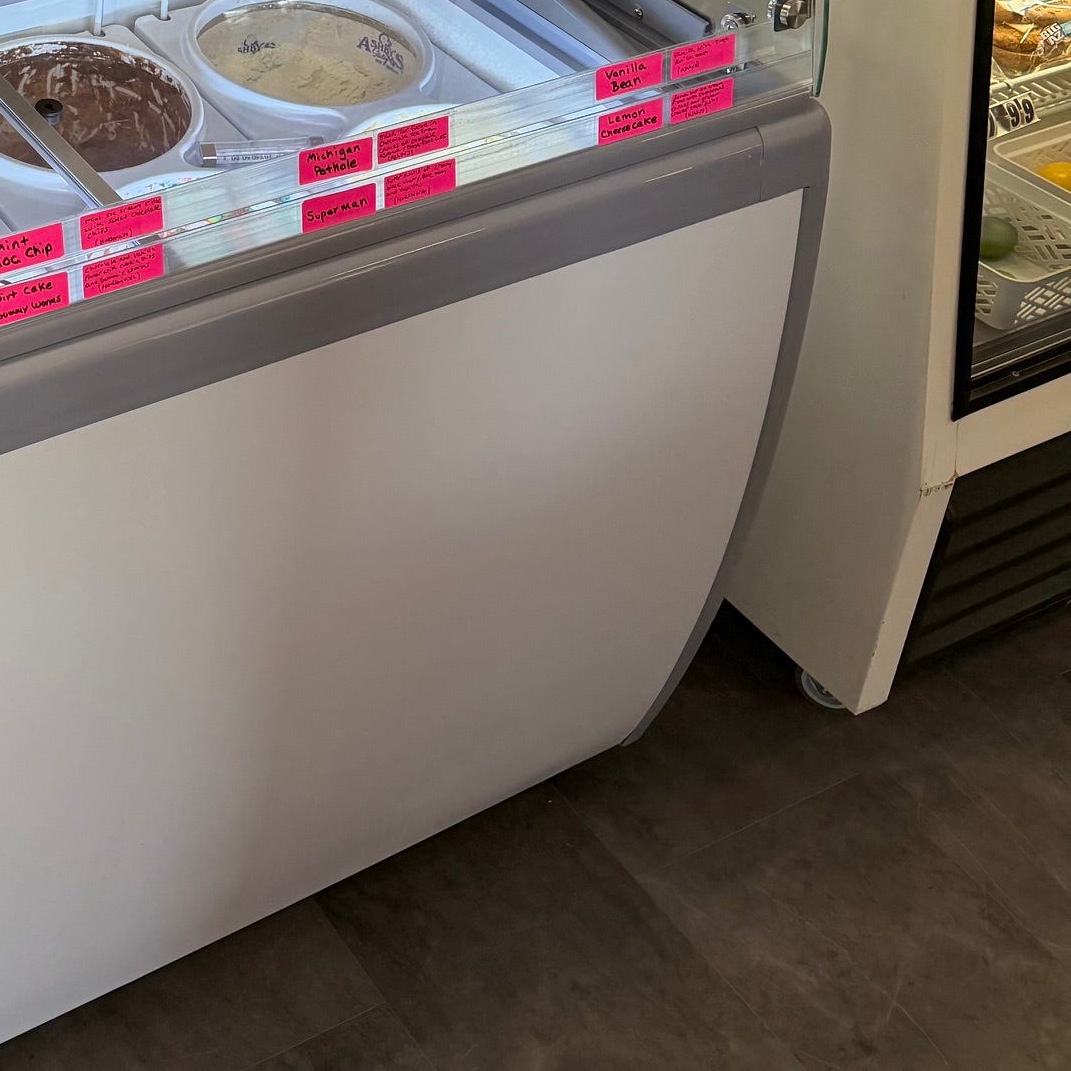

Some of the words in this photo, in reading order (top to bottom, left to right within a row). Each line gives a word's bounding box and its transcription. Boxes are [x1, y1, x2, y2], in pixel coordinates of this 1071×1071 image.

[1040, 23, 1061, 41] BIG
[605, 62, 647, 79] Vanilla
[611, 76, 642, 93] Bean
[608, 108, 645, 125] Lemon
[306, 144, 361, 164] Michigan
[314, 159, 357, 177] Pothole
[25, 242, 53, 259] Chip
[23, 281, 53, 295] Cake
[31, 294, 62, 310] Worms
